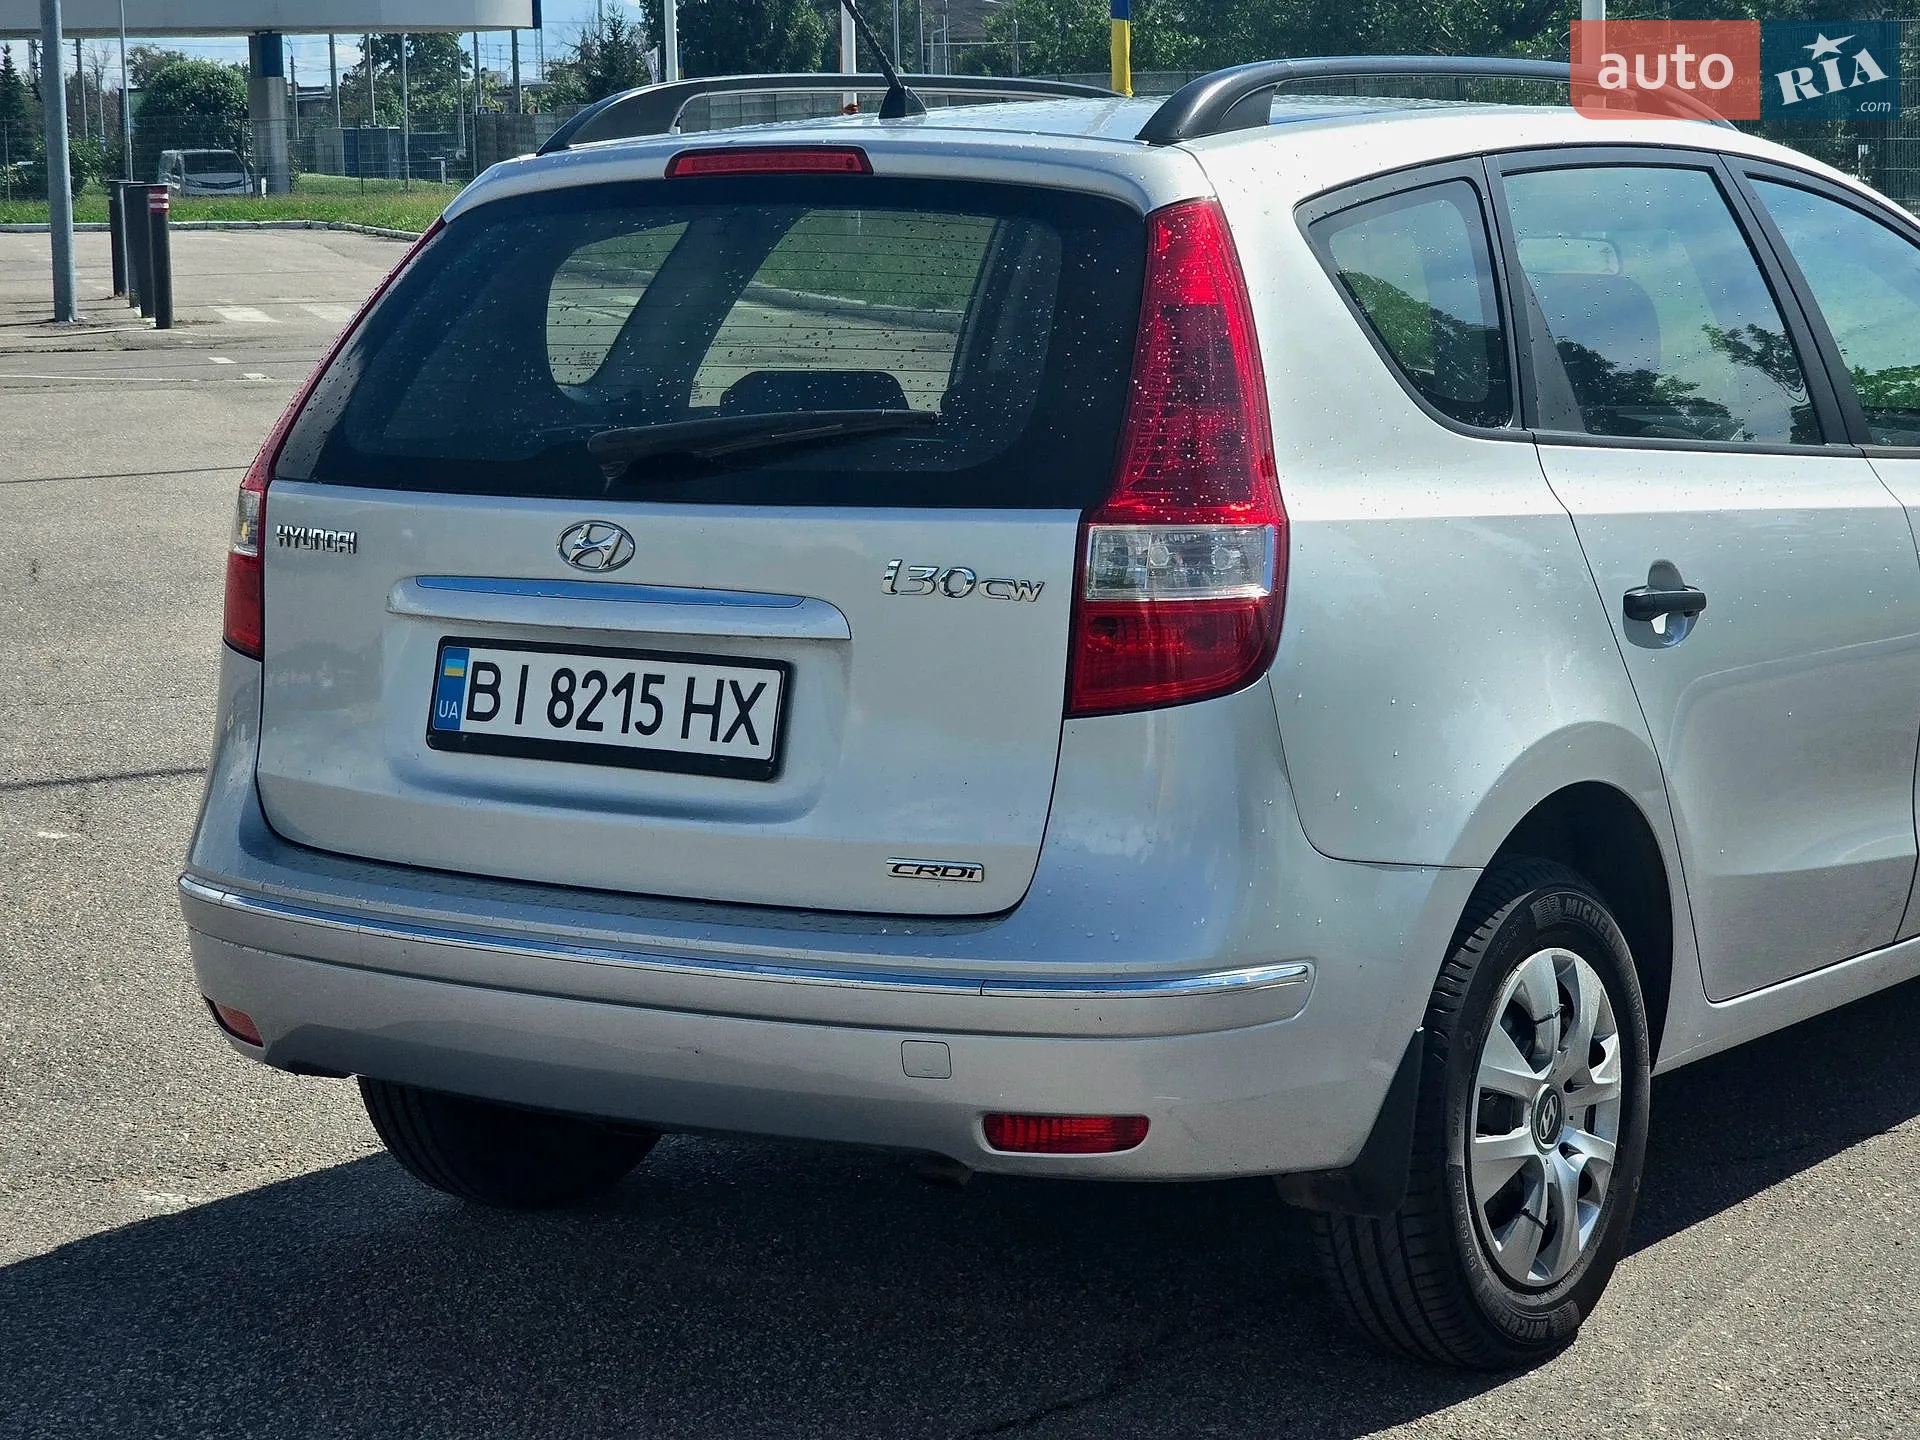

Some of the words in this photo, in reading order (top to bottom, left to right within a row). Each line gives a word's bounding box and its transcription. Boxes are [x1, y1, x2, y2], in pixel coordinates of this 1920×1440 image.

[275, 524, 357, 553] HYUNDAI
[438, 699, 459, 721] UA
[466, 661, 529, 725] BI
[546, 667, 666, 737] 8215
[680, 676, 768, 747] HX
[1460, 1219, 1478, 1272] 195/65
